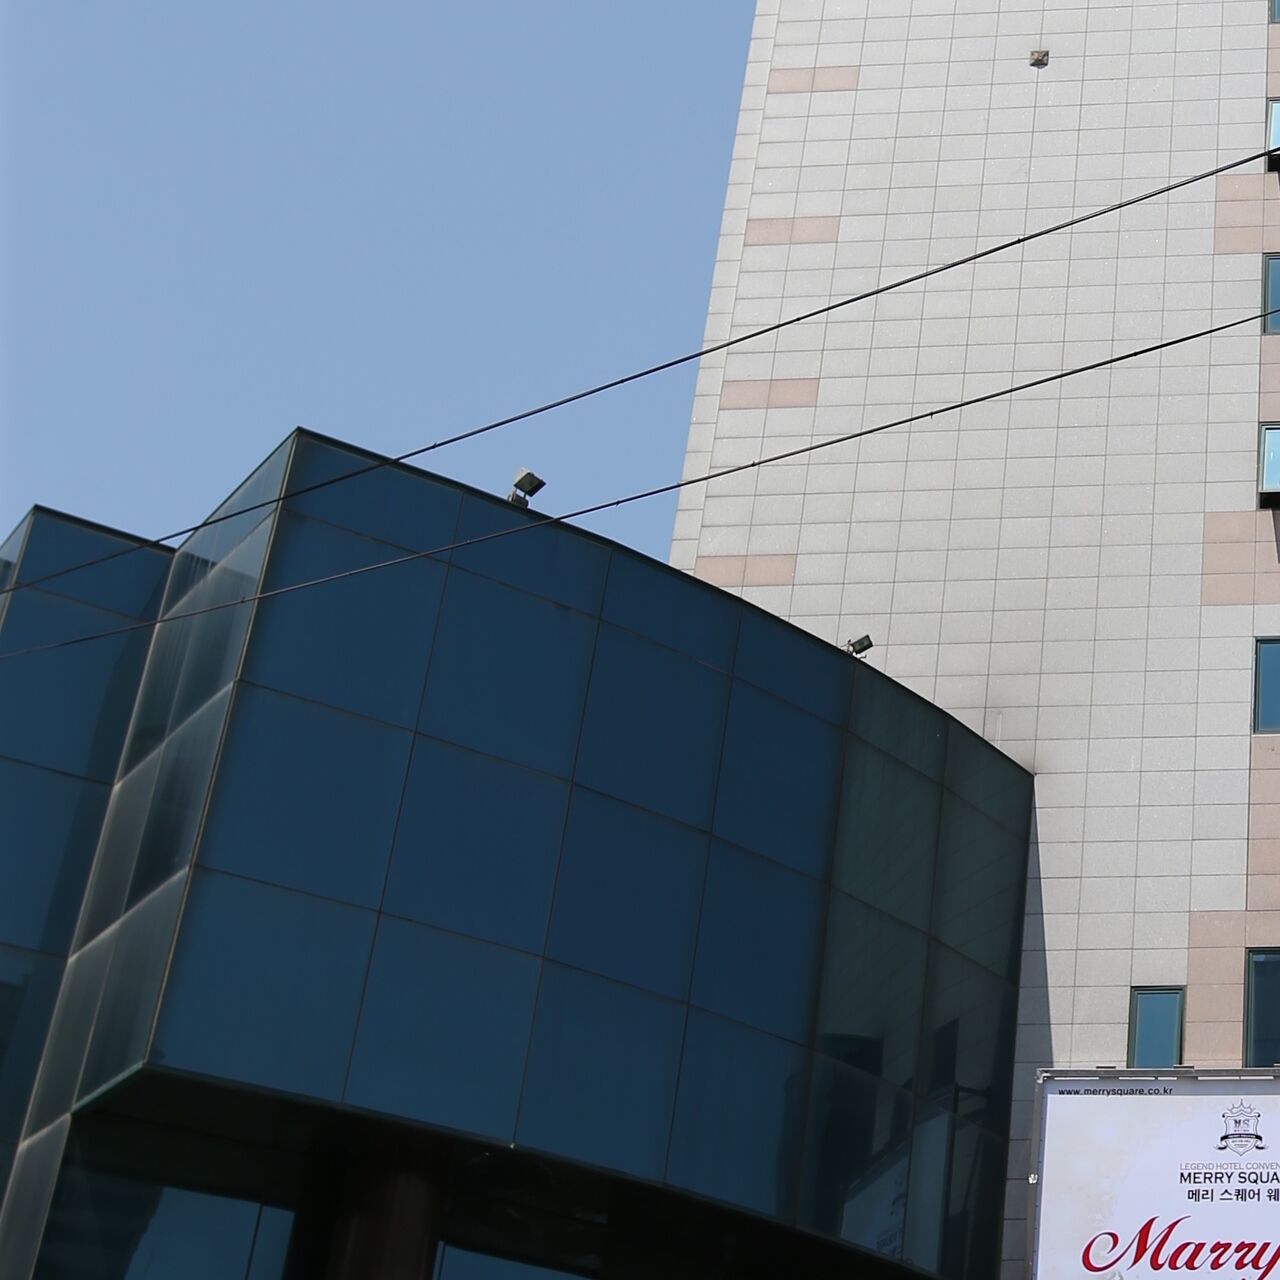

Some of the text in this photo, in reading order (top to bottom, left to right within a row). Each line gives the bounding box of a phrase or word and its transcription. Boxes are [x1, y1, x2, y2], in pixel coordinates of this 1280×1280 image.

[1058, 1086, 1173, 1096] www.merrysquare.co.kr
[1179, 1162, 1214, 1171] LEGEND
[1216, 1162, 1244, 1171] HOTEL
[1179, 1171, 1234, 1184] MERRY
[1187, 1188, 1214, 1202] 메리
[1219, 1188, 1260, 1202] 스퀘어
